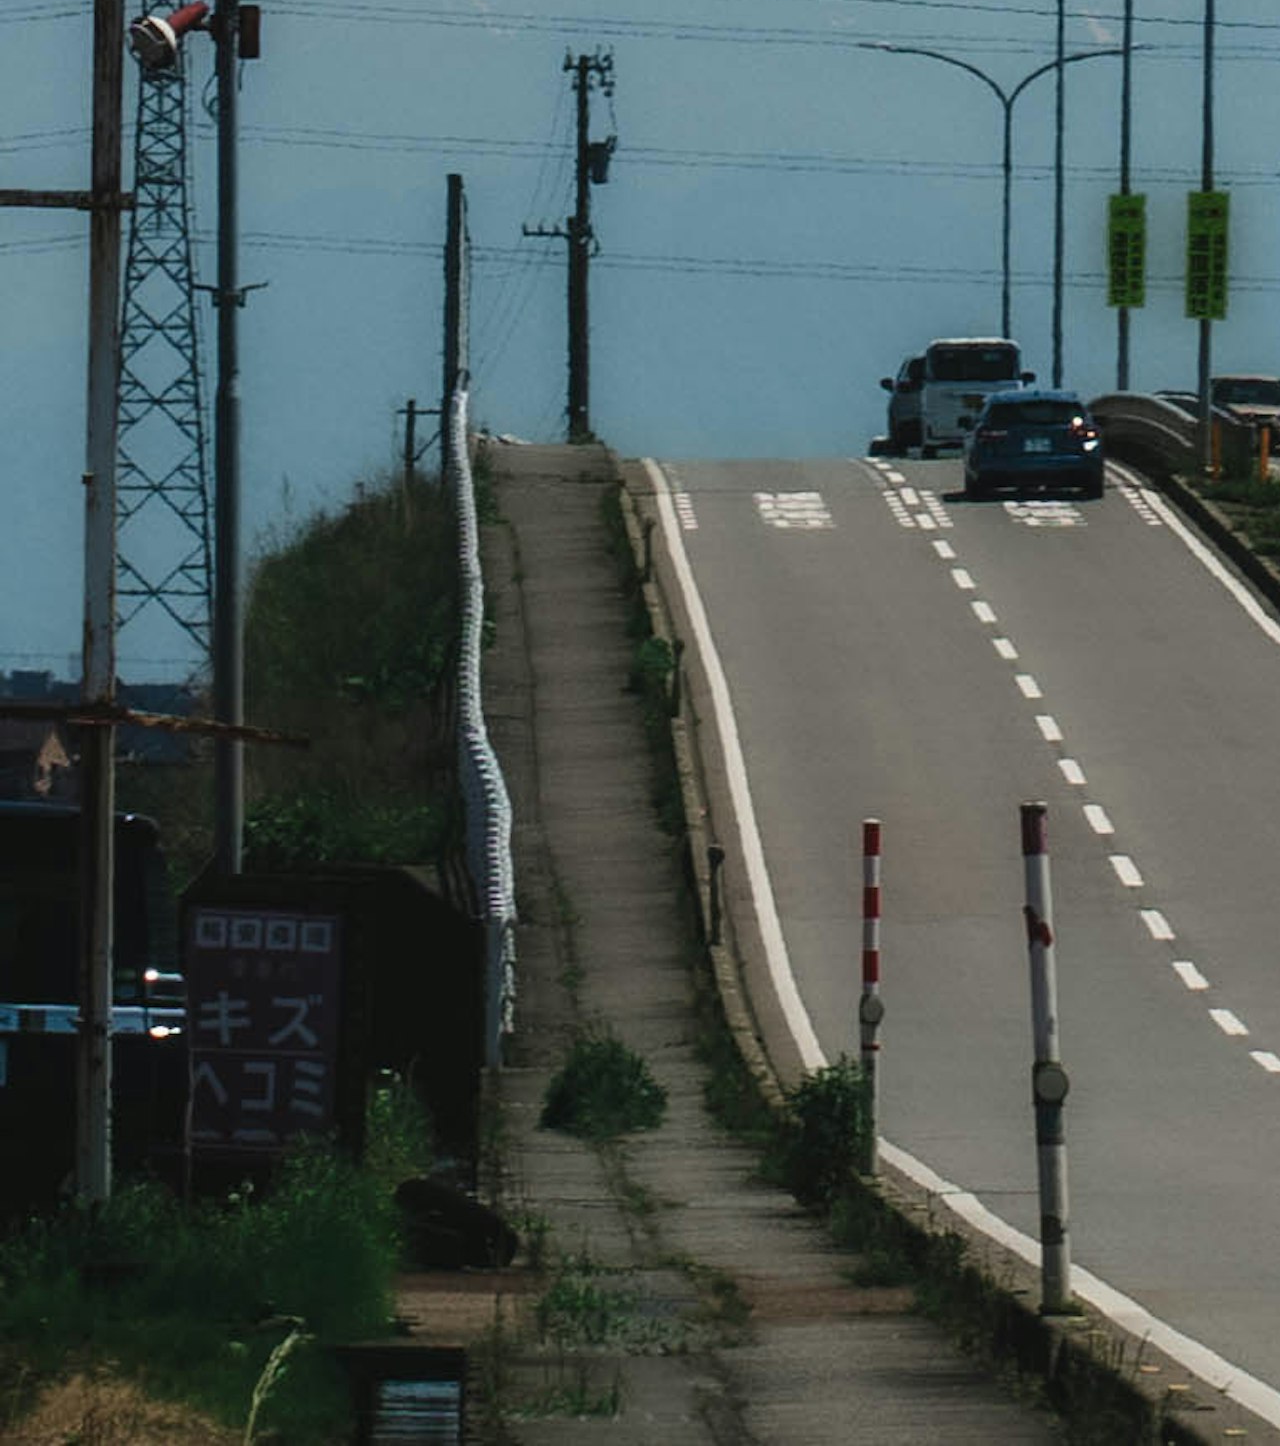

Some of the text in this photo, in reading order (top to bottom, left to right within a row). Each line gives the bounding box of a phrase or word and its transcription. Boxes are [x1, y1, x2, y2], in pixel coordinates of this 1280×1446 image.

[197, 990, 323, 1048] キズ
[194, 1060, 327, 1117] ヘコミ
